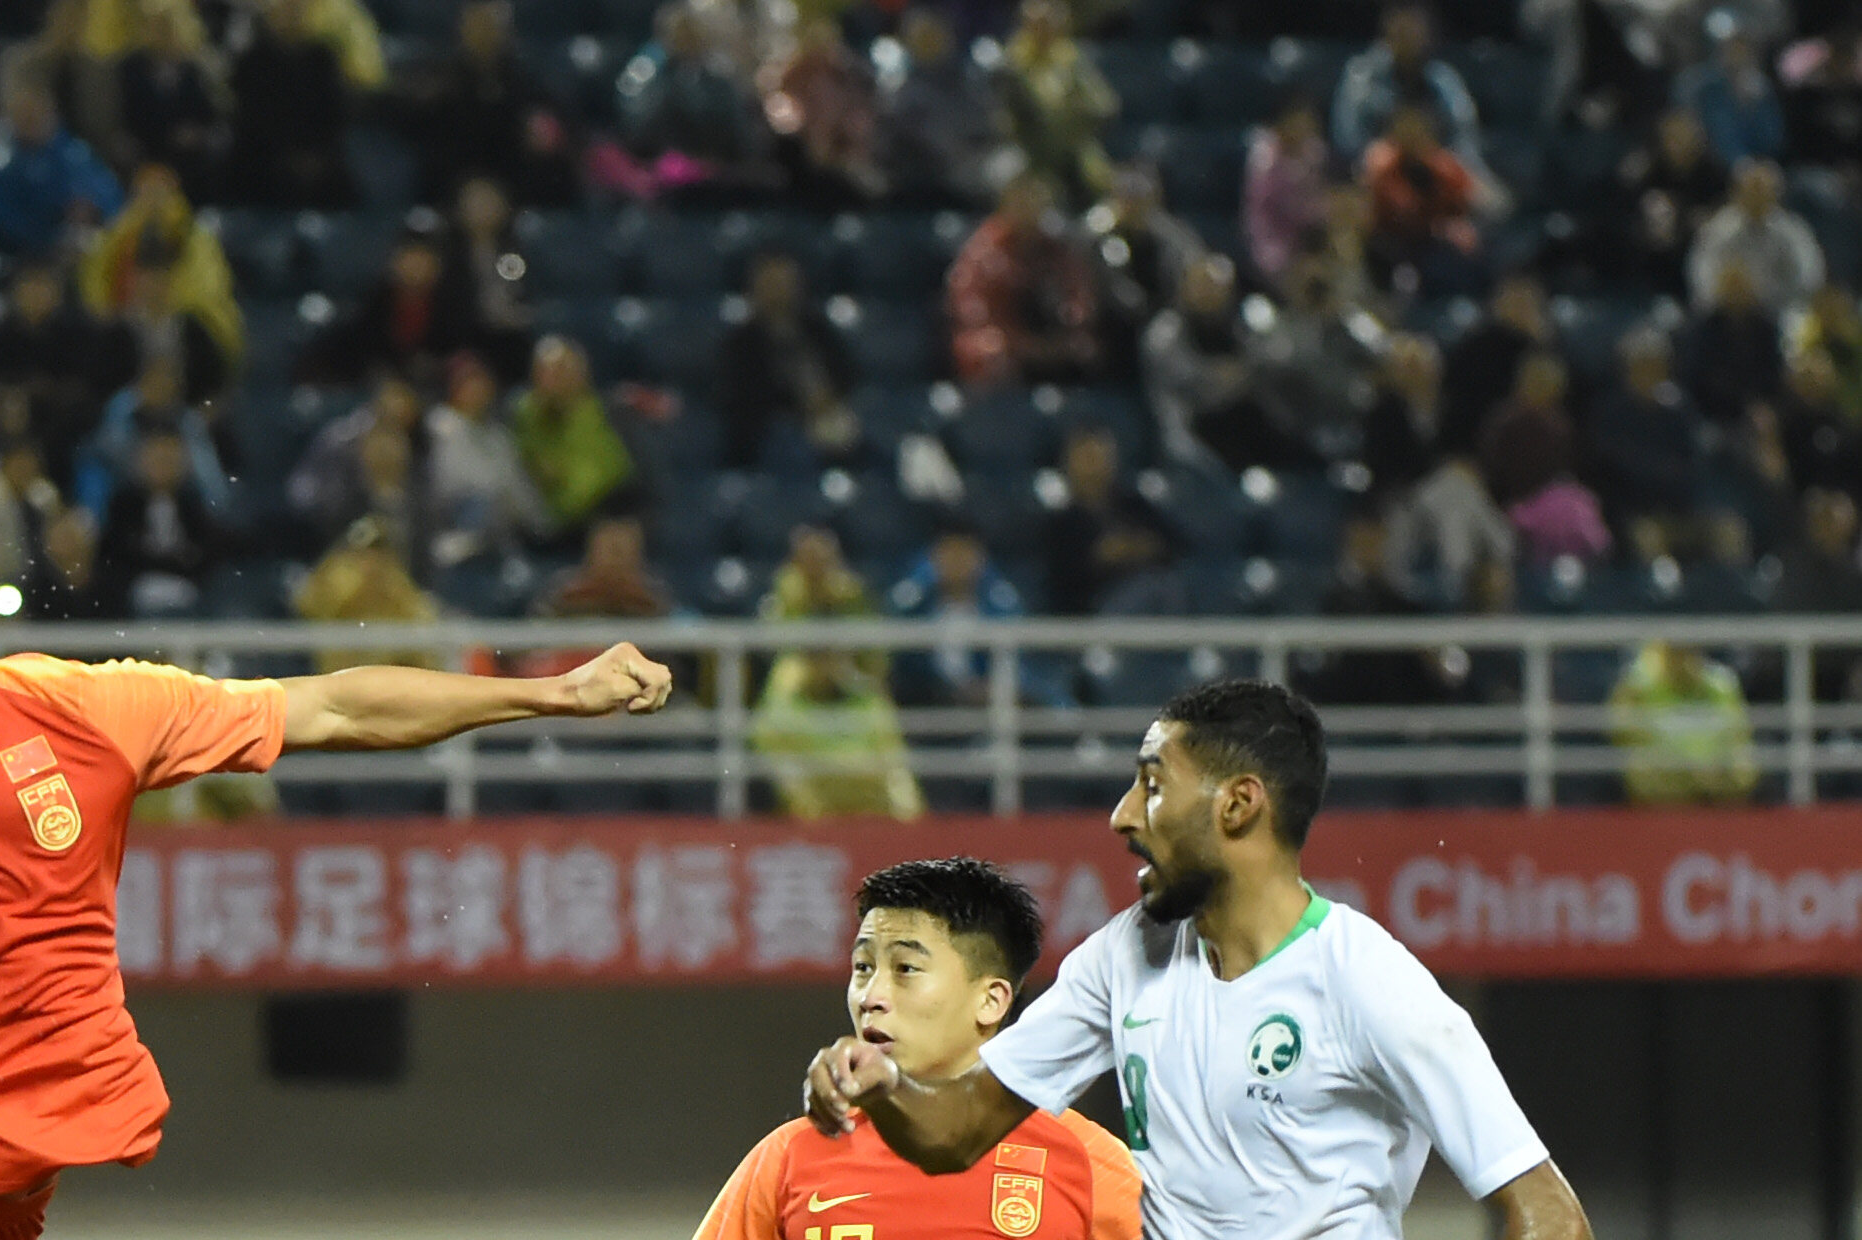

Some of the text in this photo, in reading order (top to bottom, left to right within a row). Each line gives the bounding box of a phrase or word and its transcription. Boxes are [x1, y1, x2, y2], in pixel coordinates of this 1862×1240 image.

[24, 780, 65, 805] CFA
[1389, 853, 1638, 948] China
[1246, 1084, 1284, 1105] KSA
[998, 1176, 1038, 1192] CFA
